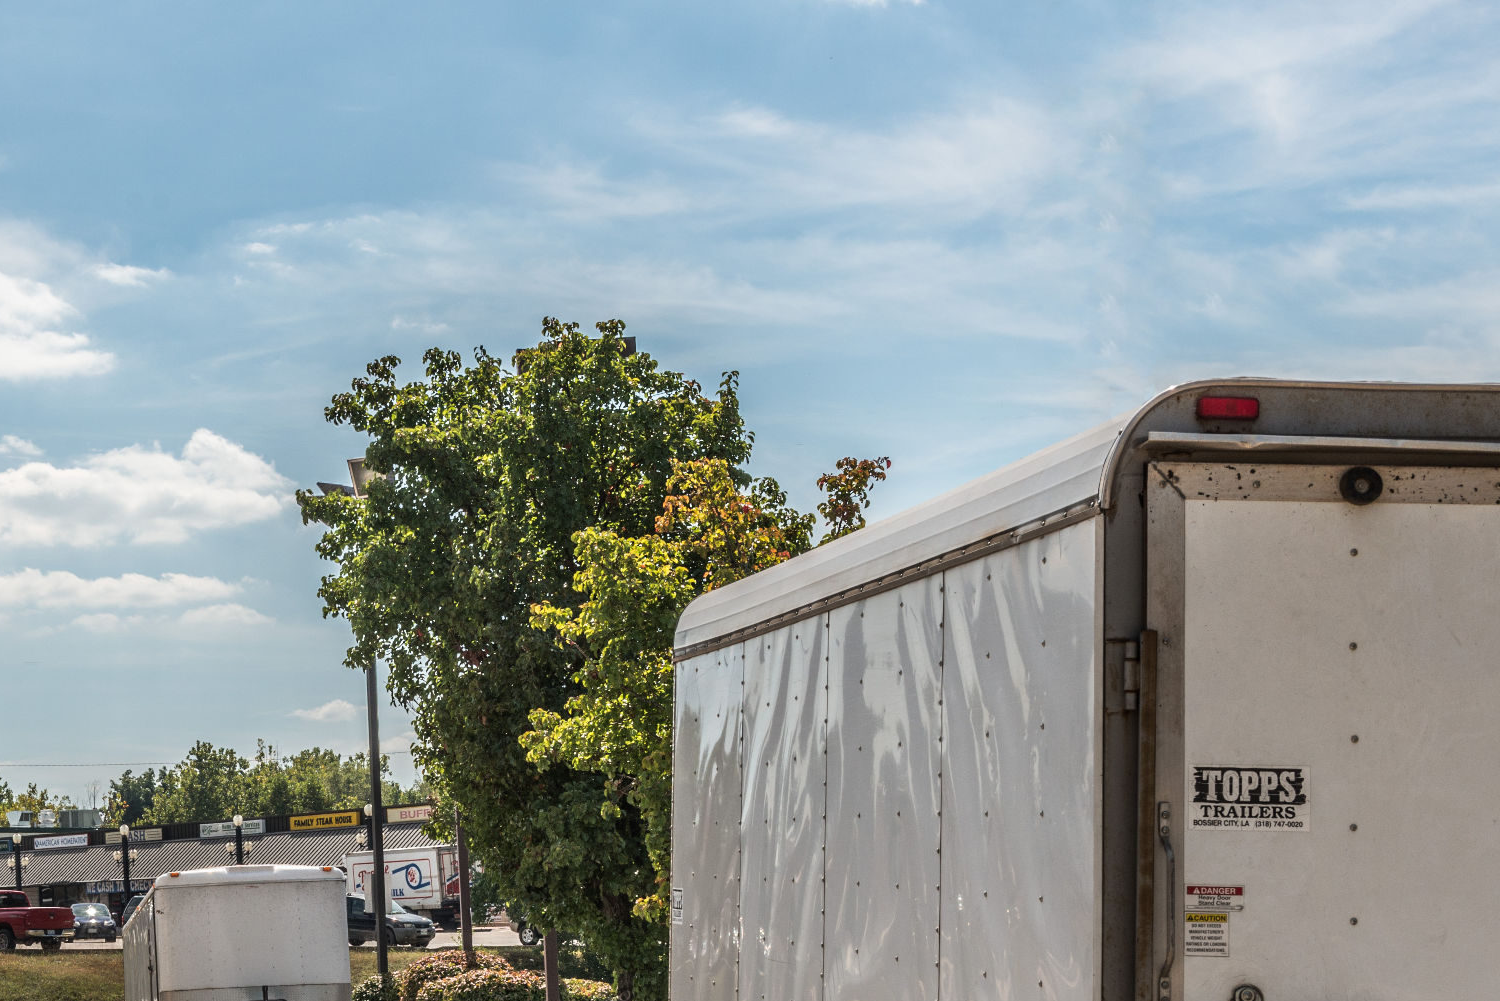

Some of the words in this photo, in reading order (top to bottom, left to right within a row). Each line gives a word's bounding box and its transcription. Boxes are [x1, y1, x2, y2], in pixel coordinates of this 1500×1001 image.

[1202, 769, 1297, 803] TOPPS
[1200, 805, 1296, 819] TRAILERS
[294, 819, 314, 828] FAMILY
[316, 817, 334, 826] STEAK
[335, 815, 353, 825] HOUSE
[128, 830, 146, 841] ASH
[97, 881, 115, 893] CASH
[116, 880, 125, 892] TA
[391, 888, 405, 897] ILK
[1201, 887, 1236, 895] DANGER
